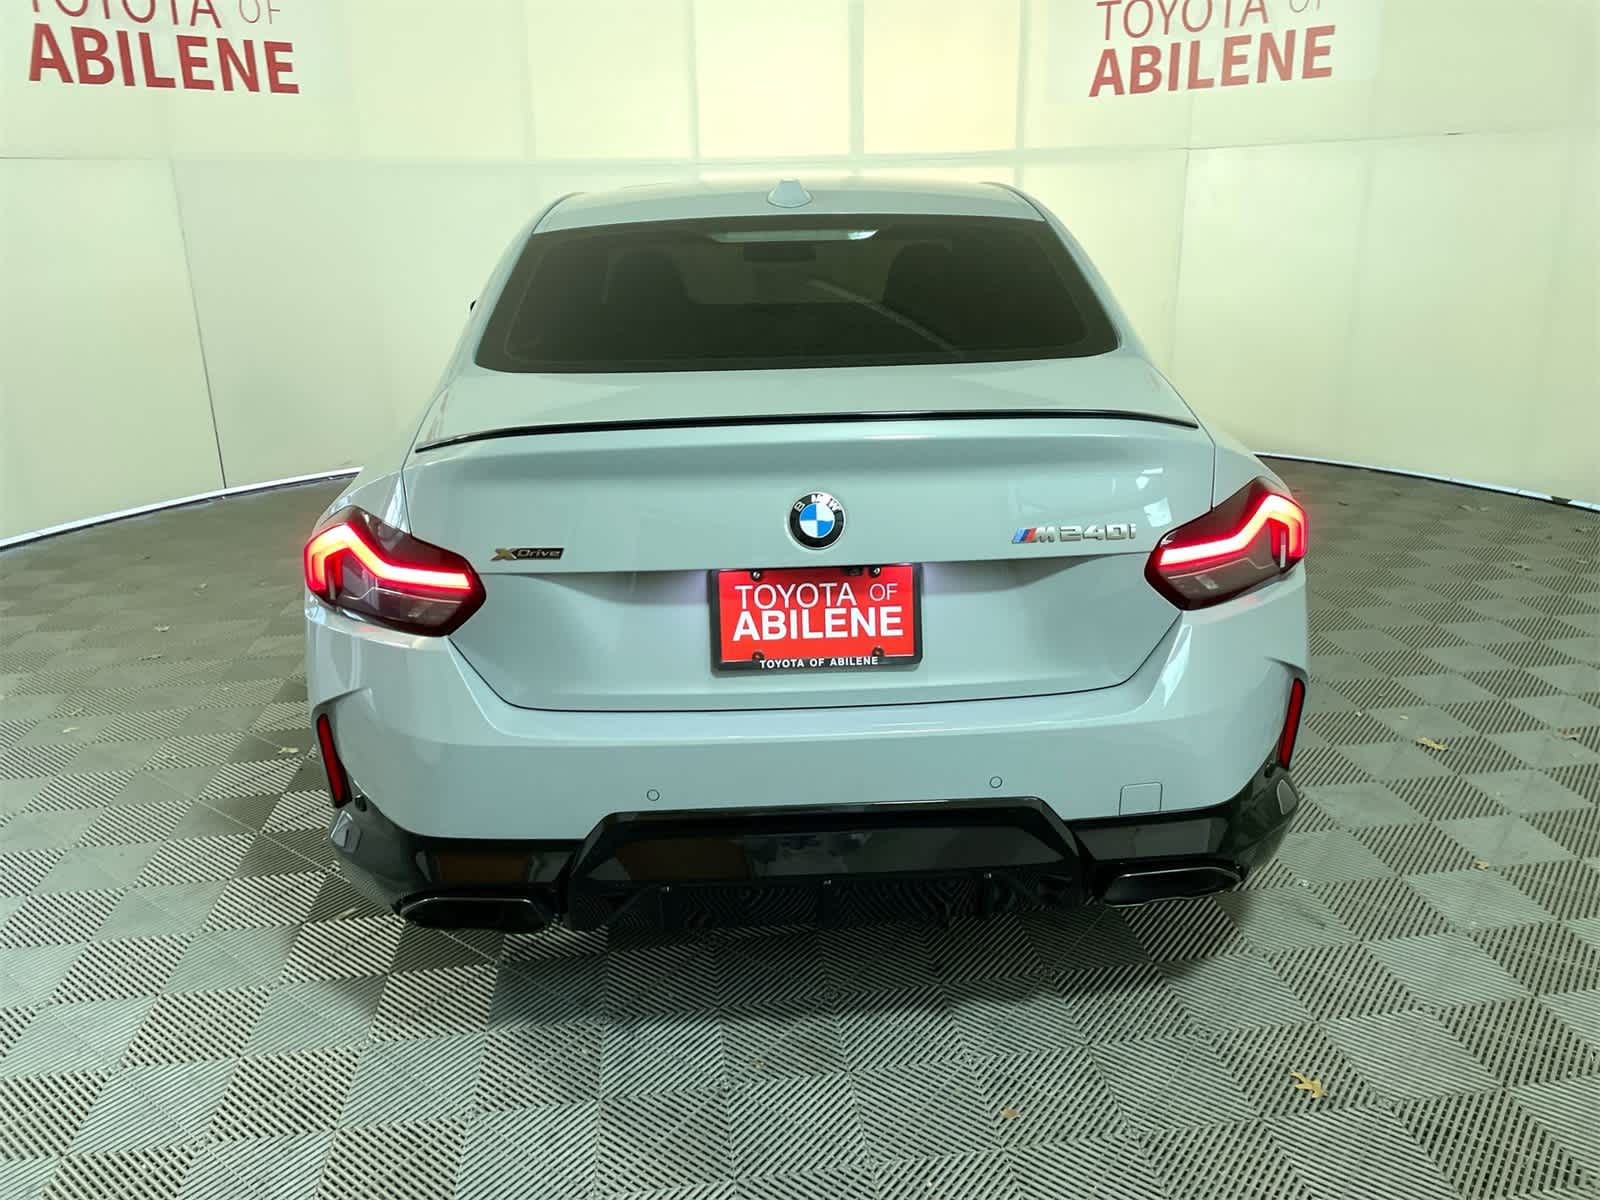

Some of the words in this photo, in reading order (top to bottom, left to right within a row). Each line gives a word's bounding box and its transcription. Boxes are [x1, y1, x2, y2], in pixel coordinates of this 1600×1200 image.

[1096, 0, 1268, 40] TOYOTA
[28, 23, 300, 94] ABILENE
[1089, 25, 1335, 97] ABILENE
[793, 494, 842, 512] BMW
[734, 583, 857, 610] TOYOTA
[869, 583, 898, 601] OF
[732, 606, 903, 641] ABILENE
[760, 659, 805, 669] TOYOTA
[809, 657, 826, 668] OF
[829, 656, 879, 667] ABILENE
